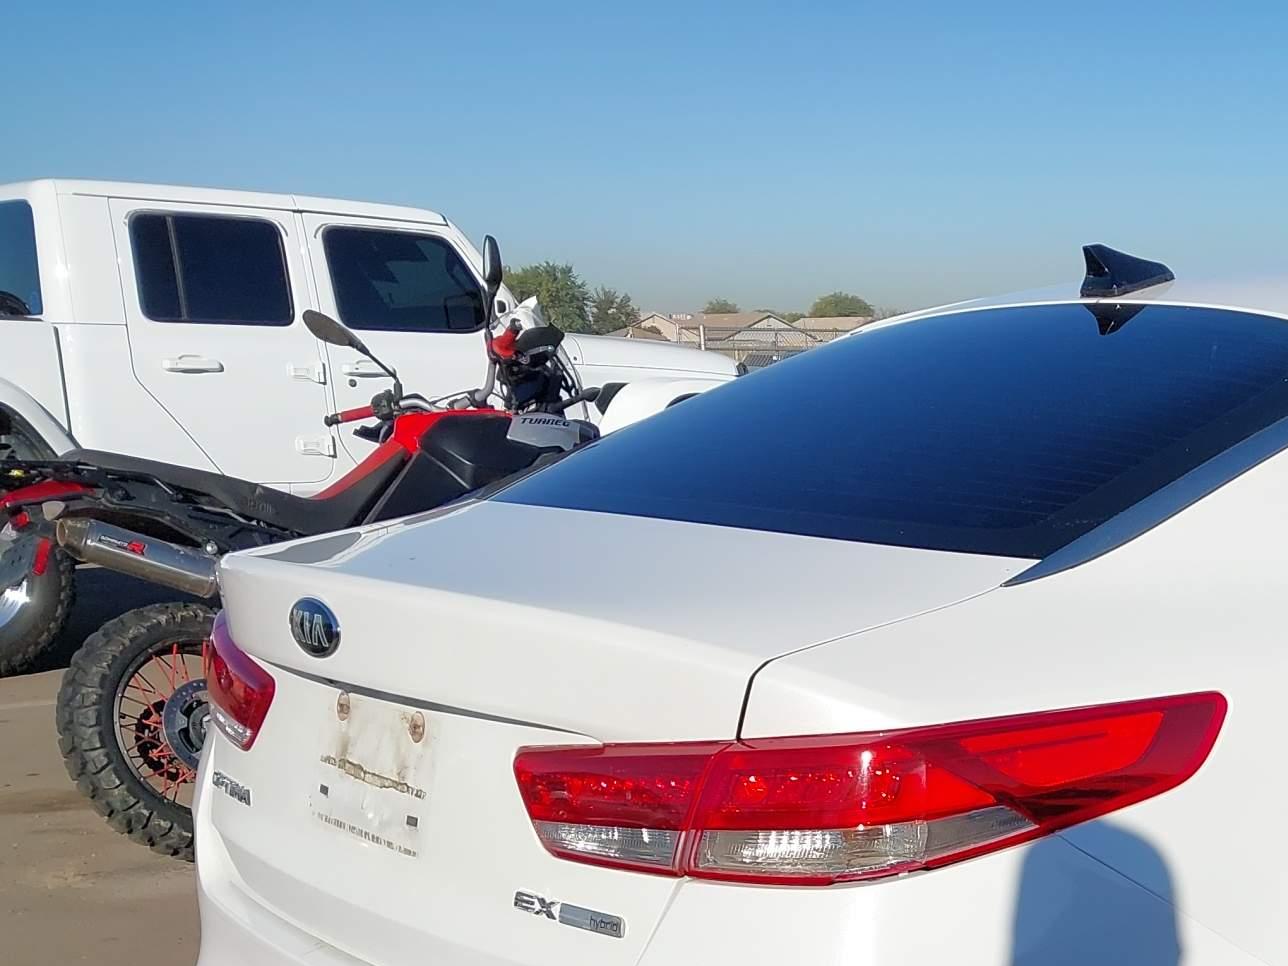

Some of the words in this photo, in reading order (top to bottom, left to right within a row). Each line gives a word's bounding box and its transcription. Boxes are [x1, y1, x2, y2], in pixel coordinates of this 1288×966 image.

[293, 607, 329, 647] KIA
[514, 891, 560, 920] EX
[589, 916, 618, 932] hybrid
